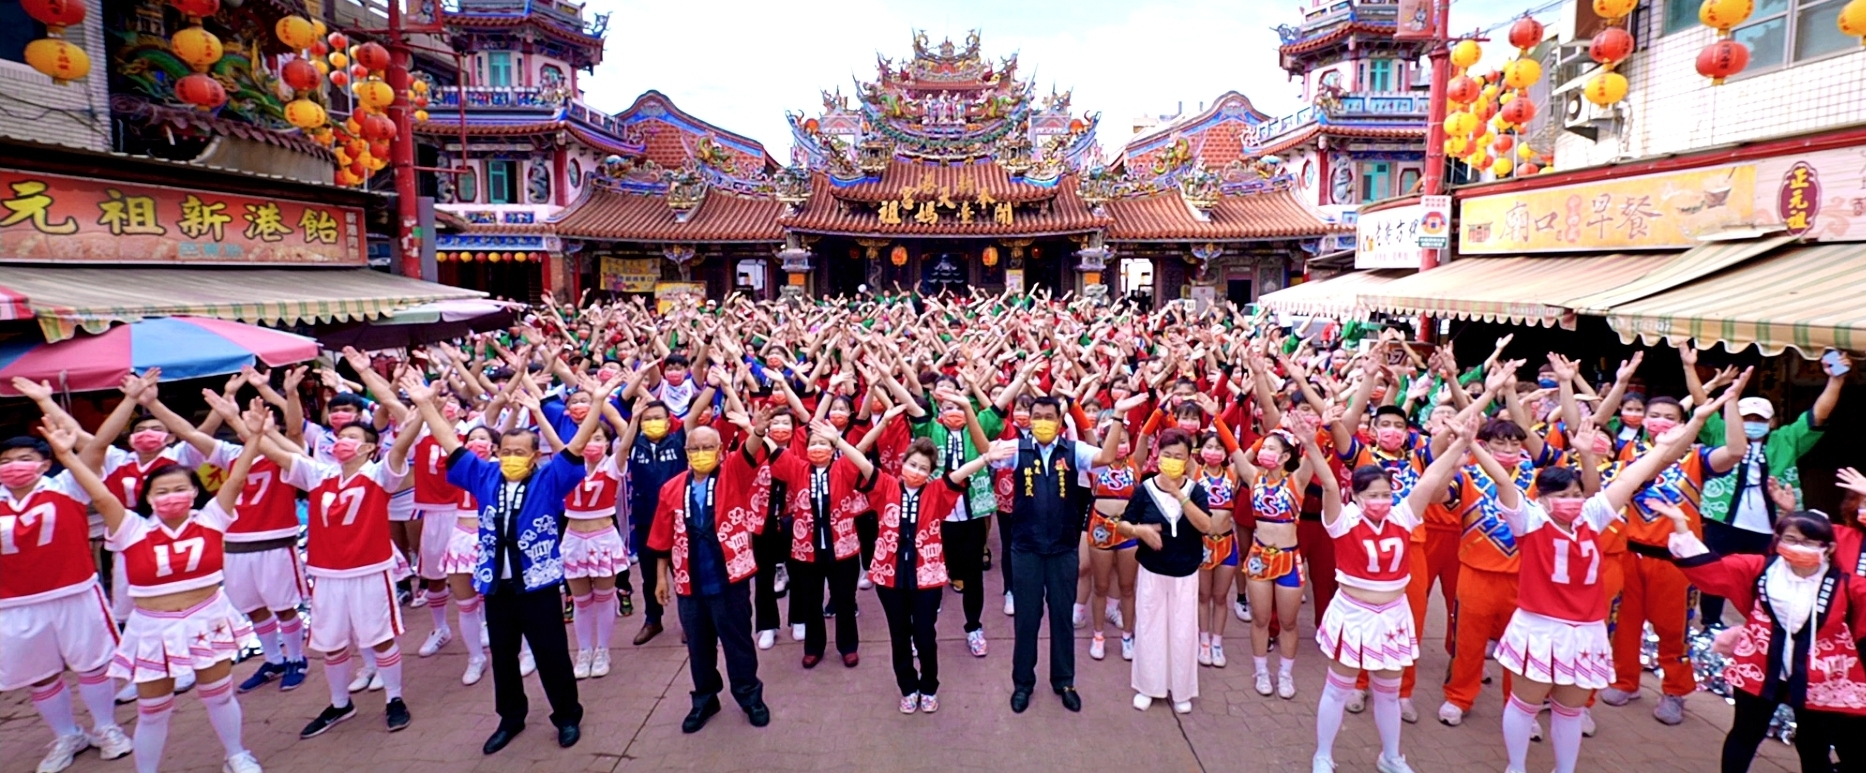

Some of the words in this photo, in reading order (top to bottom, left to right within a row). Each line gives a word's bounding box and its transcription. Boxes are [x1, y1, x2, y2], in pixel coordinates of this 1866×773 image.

[0, 180, 338, 244] 元祖新港飴
[1787, 167, 1810, 229] 正元祖
[572, 480, 604, 507] 17
[1107, 469, 1125, 491] S
[1207, 484, 1226, 506] S
[321, 486, 366, 528] 17
[1260, 494, 1281, 517] S
[0, 502, 57, 555] 17
[153, 536, 206, 578] 17
[1362, 537, 1404, 574] 17
[1551, 538, 1601, 585] 17
